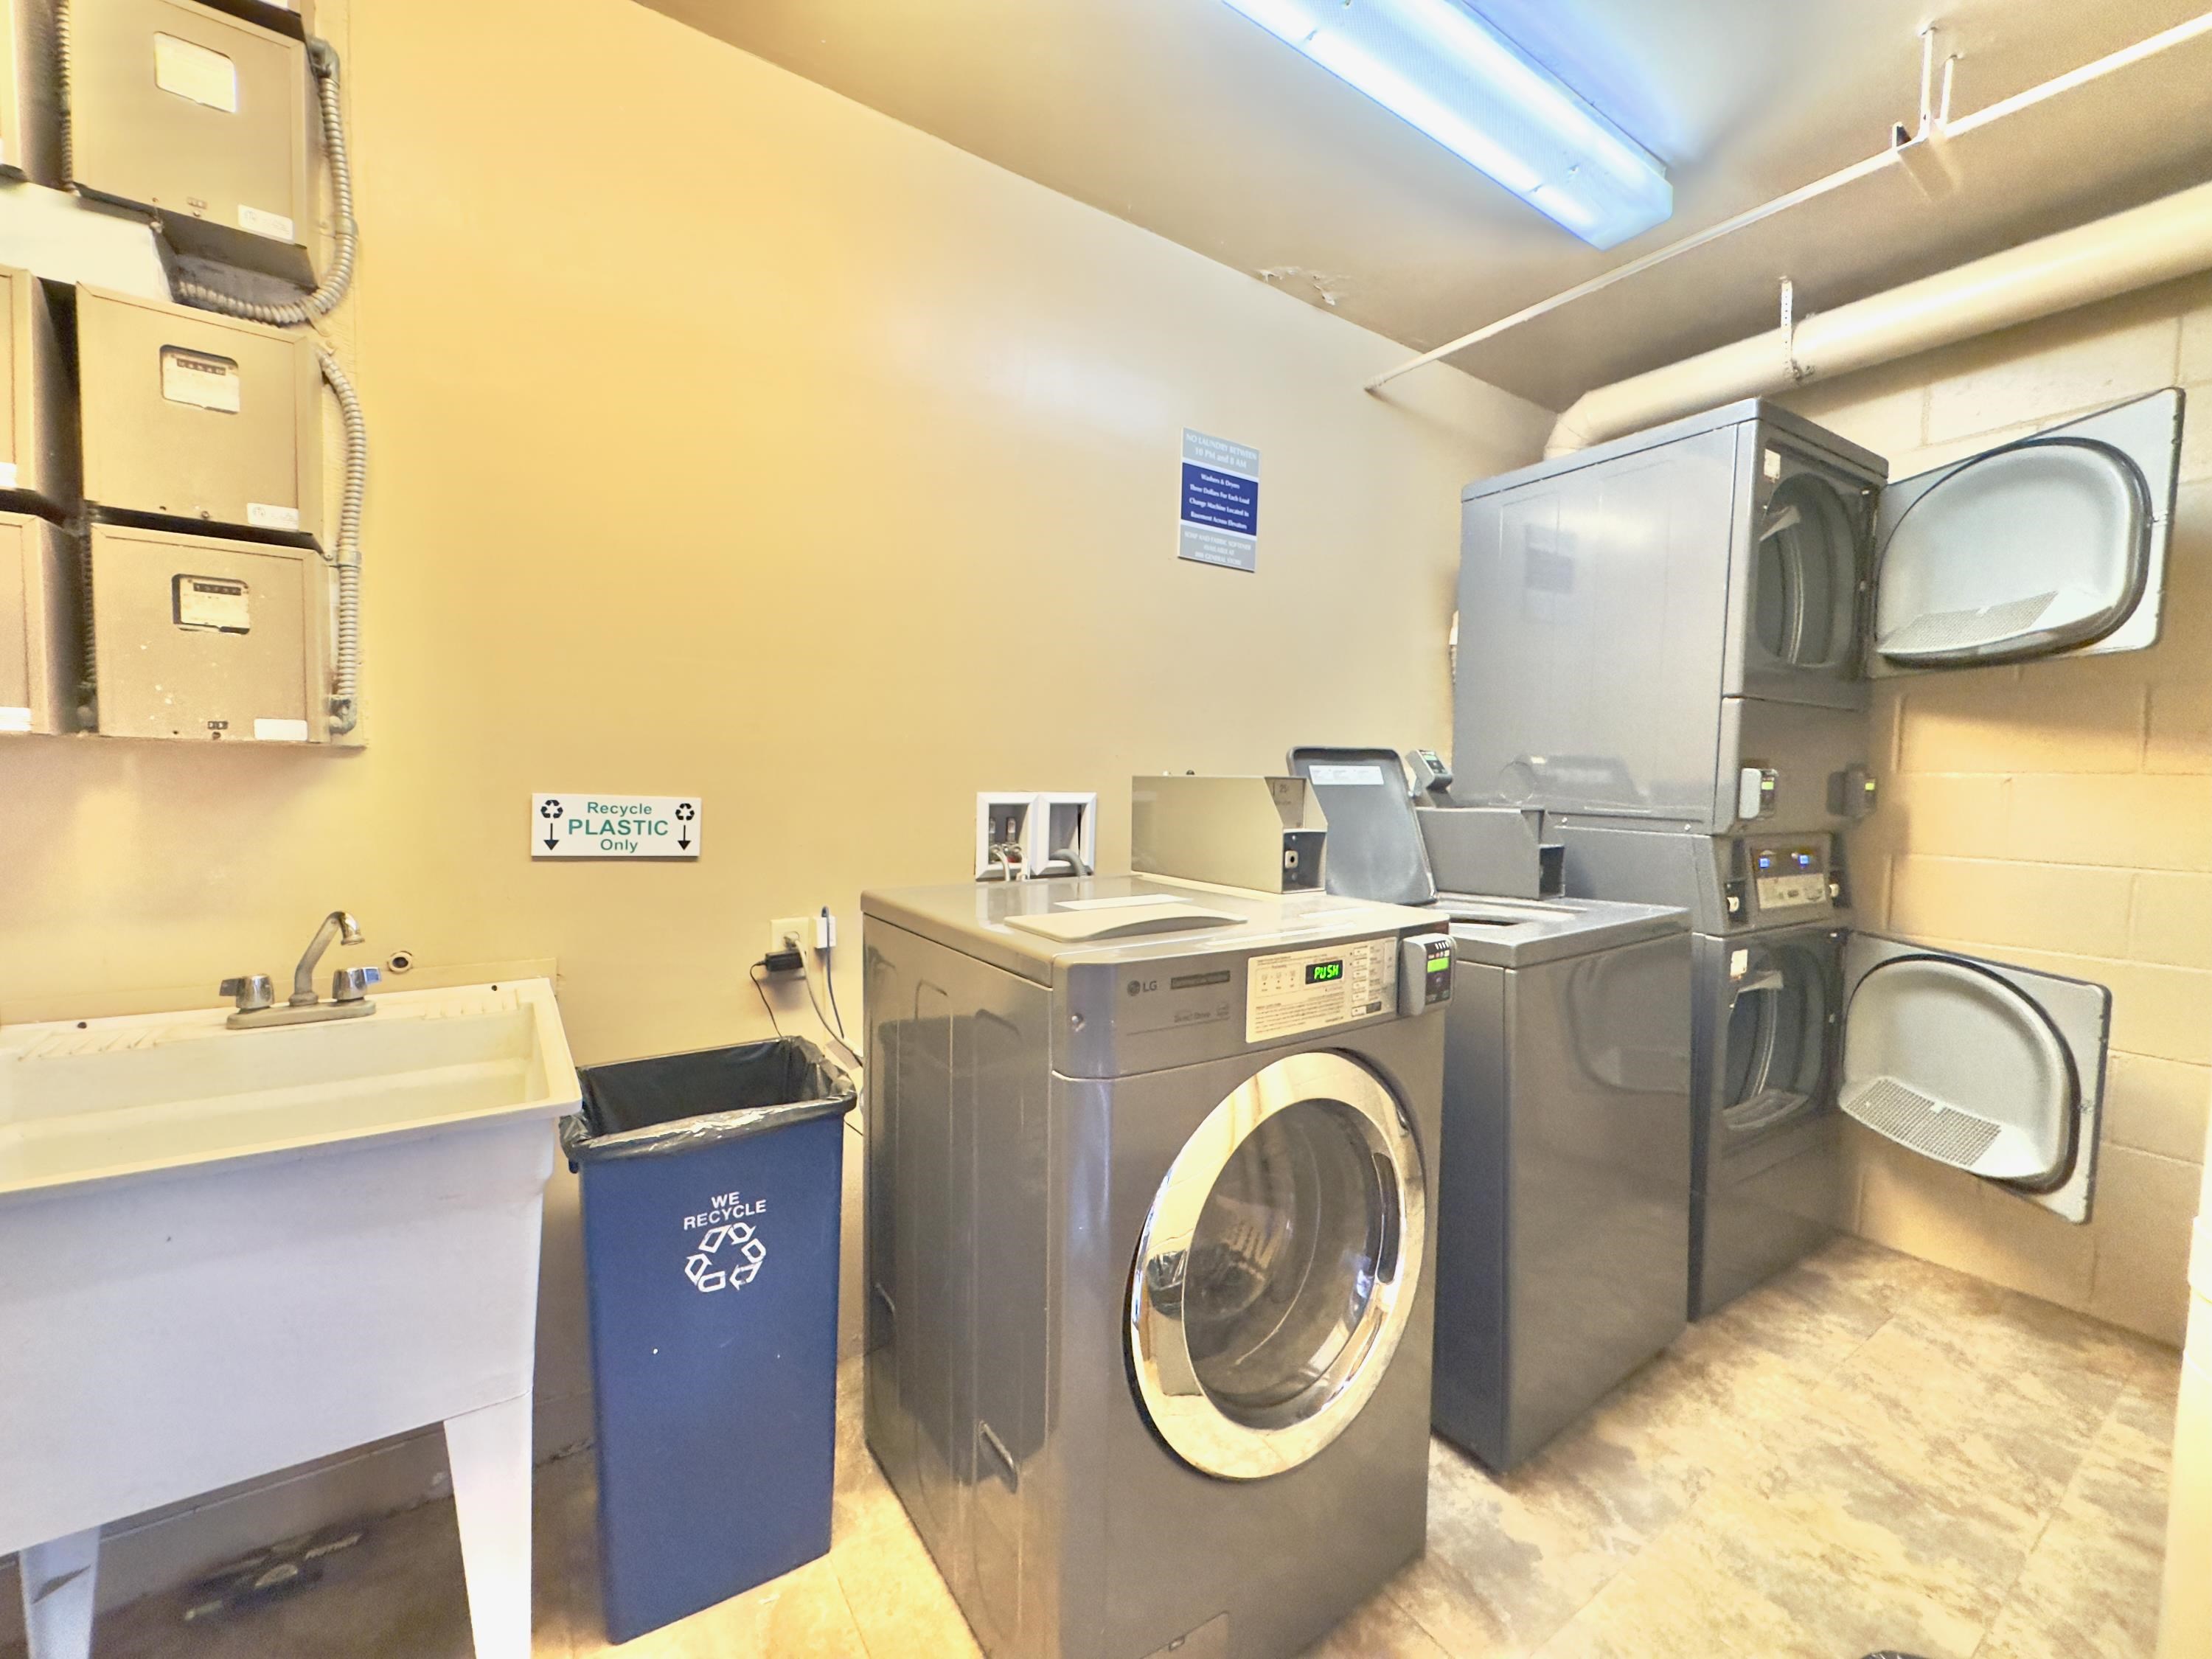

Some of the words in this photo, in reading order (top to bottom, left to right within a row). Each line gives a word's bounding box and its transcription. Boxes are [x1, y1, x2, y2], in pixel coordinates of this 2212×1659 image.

[1186, 434, 1197, 443] NO
[1198, 438, 1228, 452] LAUNDRY
[1229, 445, 1256, 460] BETWEEN
[1195, 447, 1203, 456] 10
[1205, 449, 1216, 461] PM
[1217, 454, 1228, 464] and
[1235, 459, 1247, 469] AM
[1200, 473, 1220, 484] Washers
[1225, 479, 1240, 489] Dryers
[1203, 487, 1220, 497] Dollars
[1228, 493, 1239, 501] Each
[1189, 497, 1206, 507] Change
[1207, 501, 1226, 512] Machine
[1226, 506, 1244, 516] Located
[587, 801, 653, 817] Recycle
[568, 819, 669, 835] PLASTIC
[600, 838, 638, 853] Only
[1314, 964, 1339, 980] PUSH
[1143, 981, 1158, 992] LG
[711, 1192, 740, 1209] WE
[684, 1200, 767, 1231] RECYCLE
